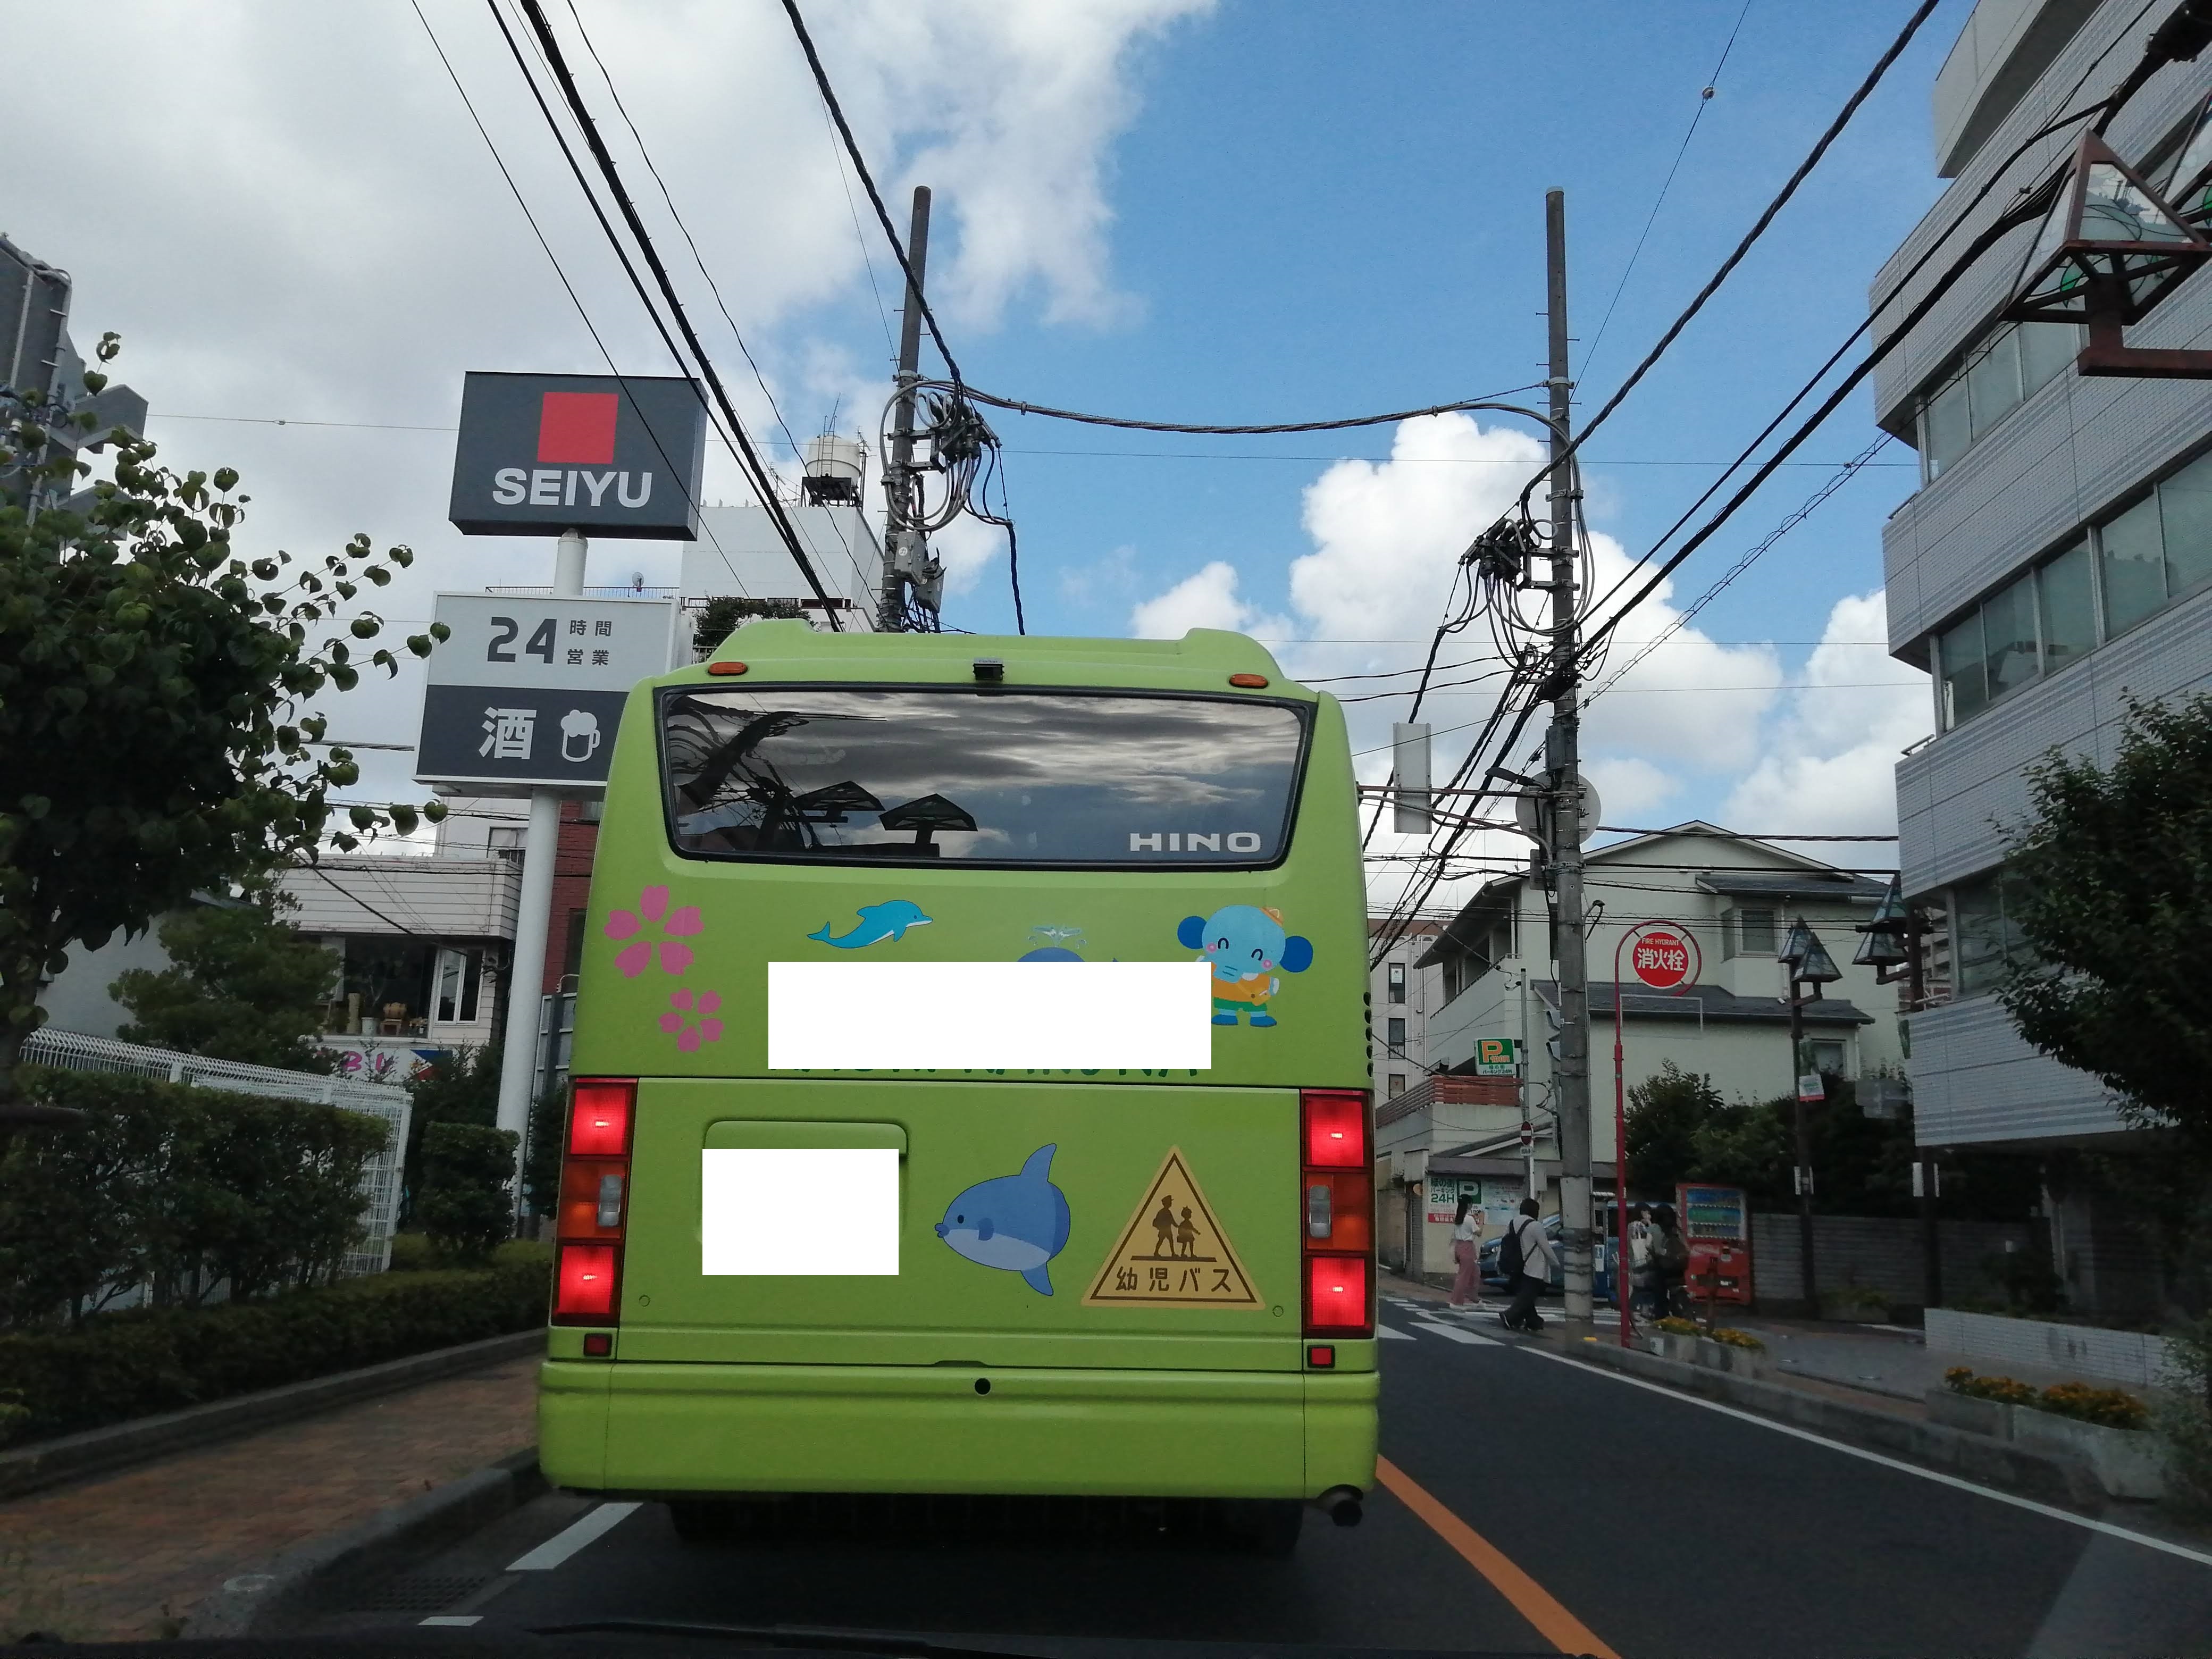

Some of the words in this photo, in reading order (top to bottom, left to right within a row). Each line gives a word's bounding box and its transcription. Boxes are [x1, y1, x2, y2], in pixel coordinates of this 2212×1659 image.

[492, 467, 653, 508] SEIYU
[487, 616, 557, 664] 24
[569, 619, 612, 637] 時間
[567, 648, 609, 666] 営業
[479, 706, 537, 760] 酒
[1129, 832, 1261, 853] HINO
[1637, 948, 1685, 971] 消火栓
[1481, 1040, 1503, 1063] P
[1431, 1193, 1454, 1203] 24H
[1116, 1266, 1231, 1293] 幼児バス
